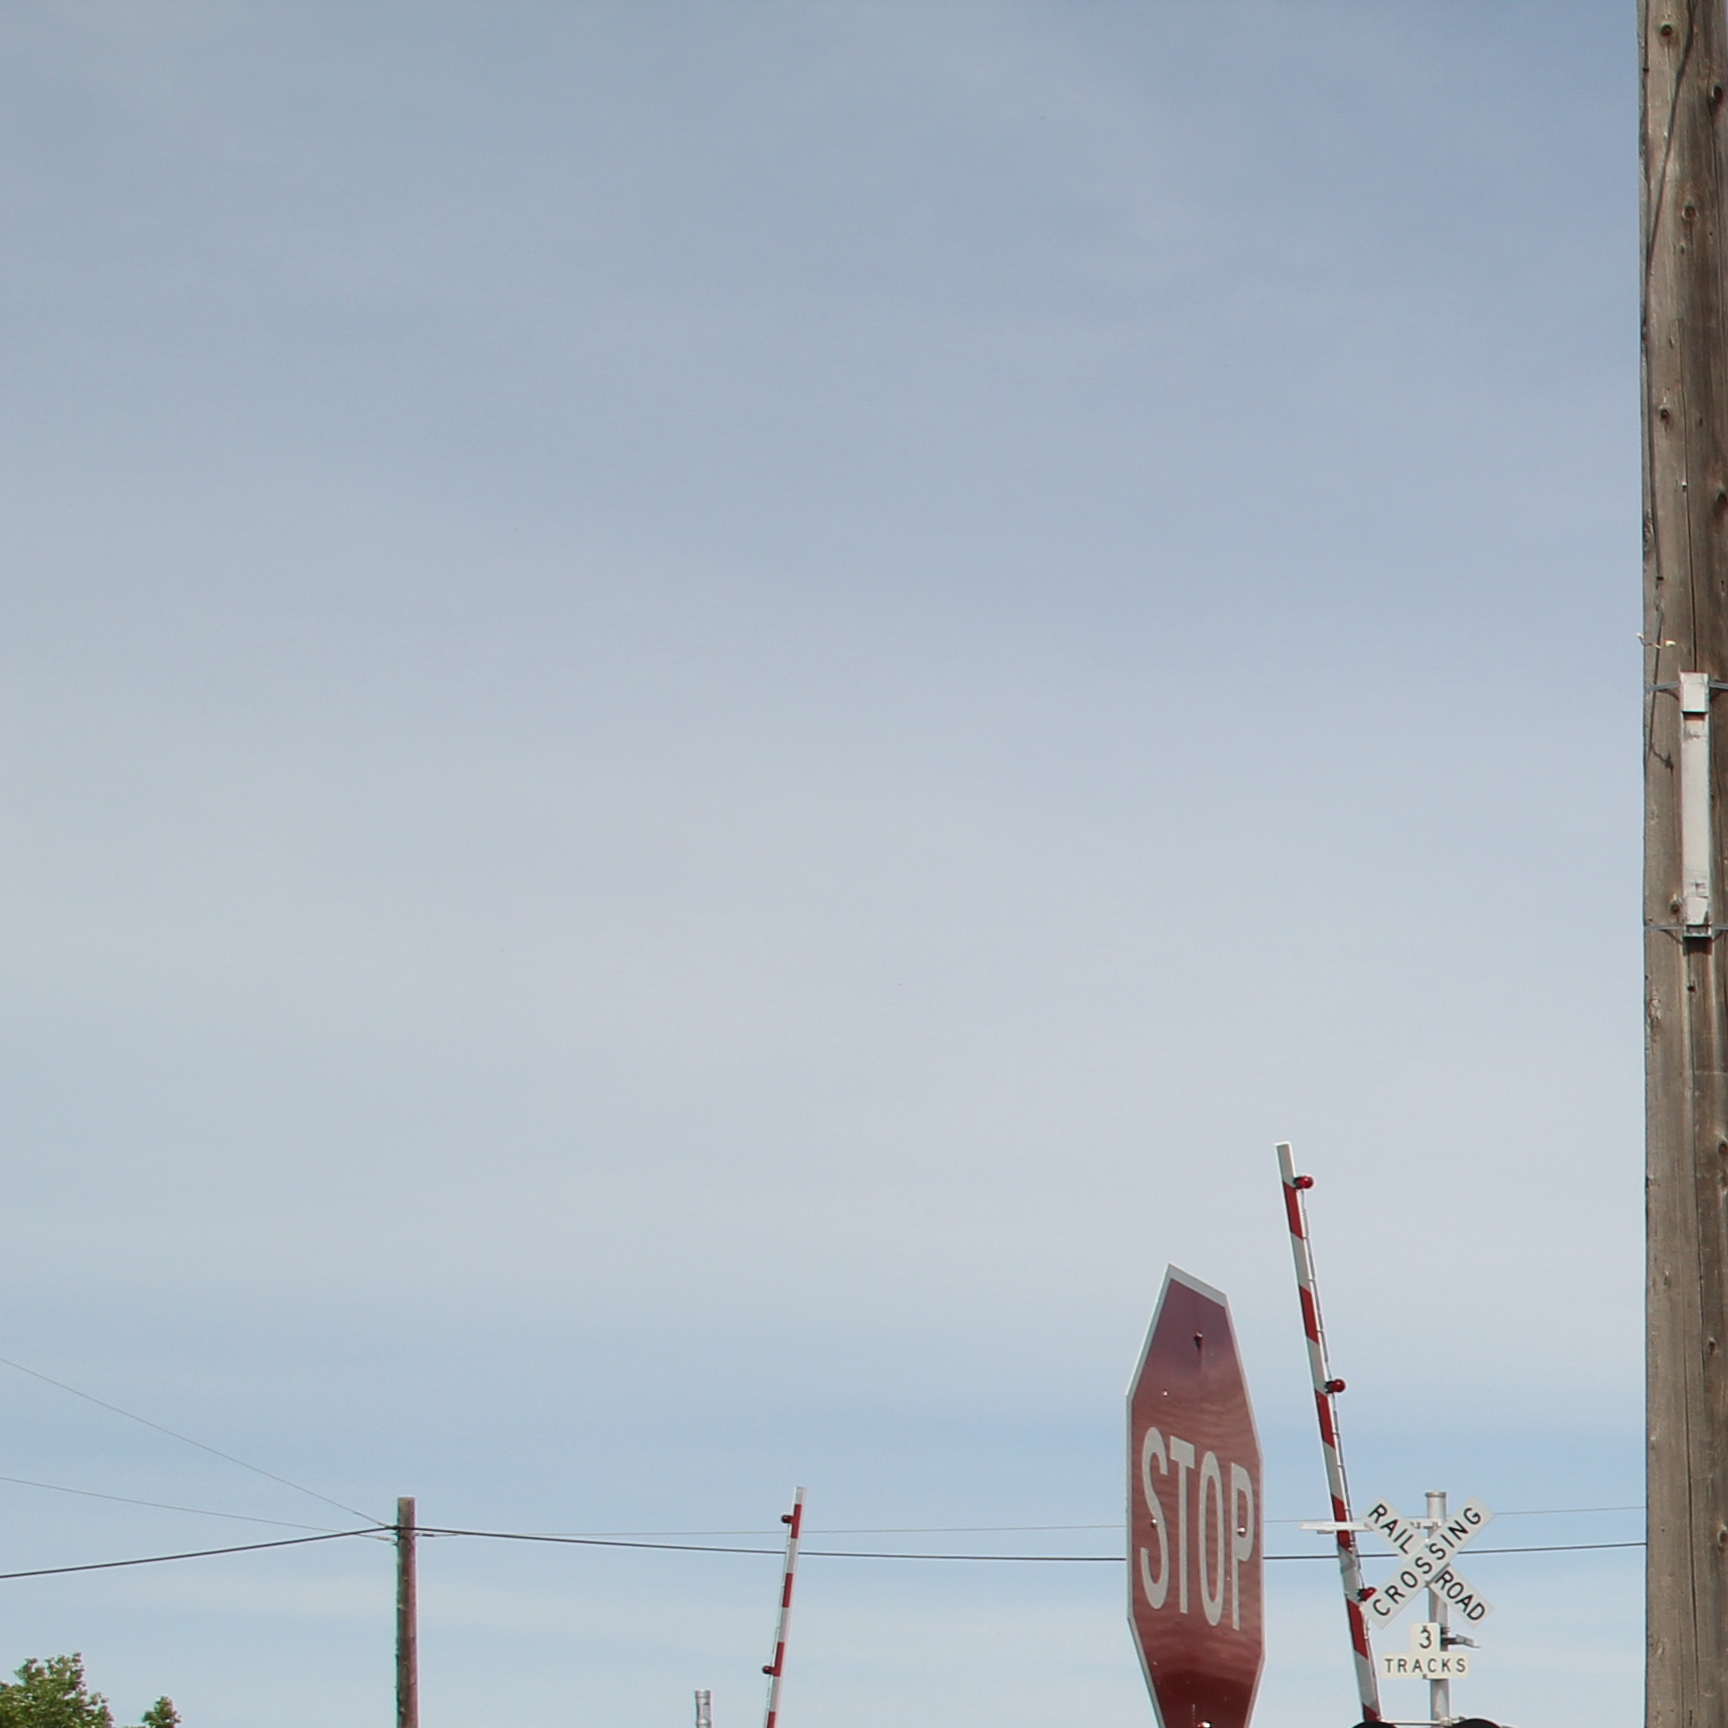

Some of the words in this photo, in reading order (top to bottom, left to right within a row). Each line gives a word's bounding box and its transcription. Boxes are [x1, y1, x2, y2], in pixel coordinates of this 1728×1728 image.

[1140, 1427, 1255, 1631] STOP
[1367, 1503, 1414, 1555] RAIL
[1434, 1570, 1486, 1621] ROAD
[1372, 1507, 1482, 1617] CROSSING
[1384, 1658, 1467, 1673] TRACKS
[1419, 1627, 1432, 1649] 3
